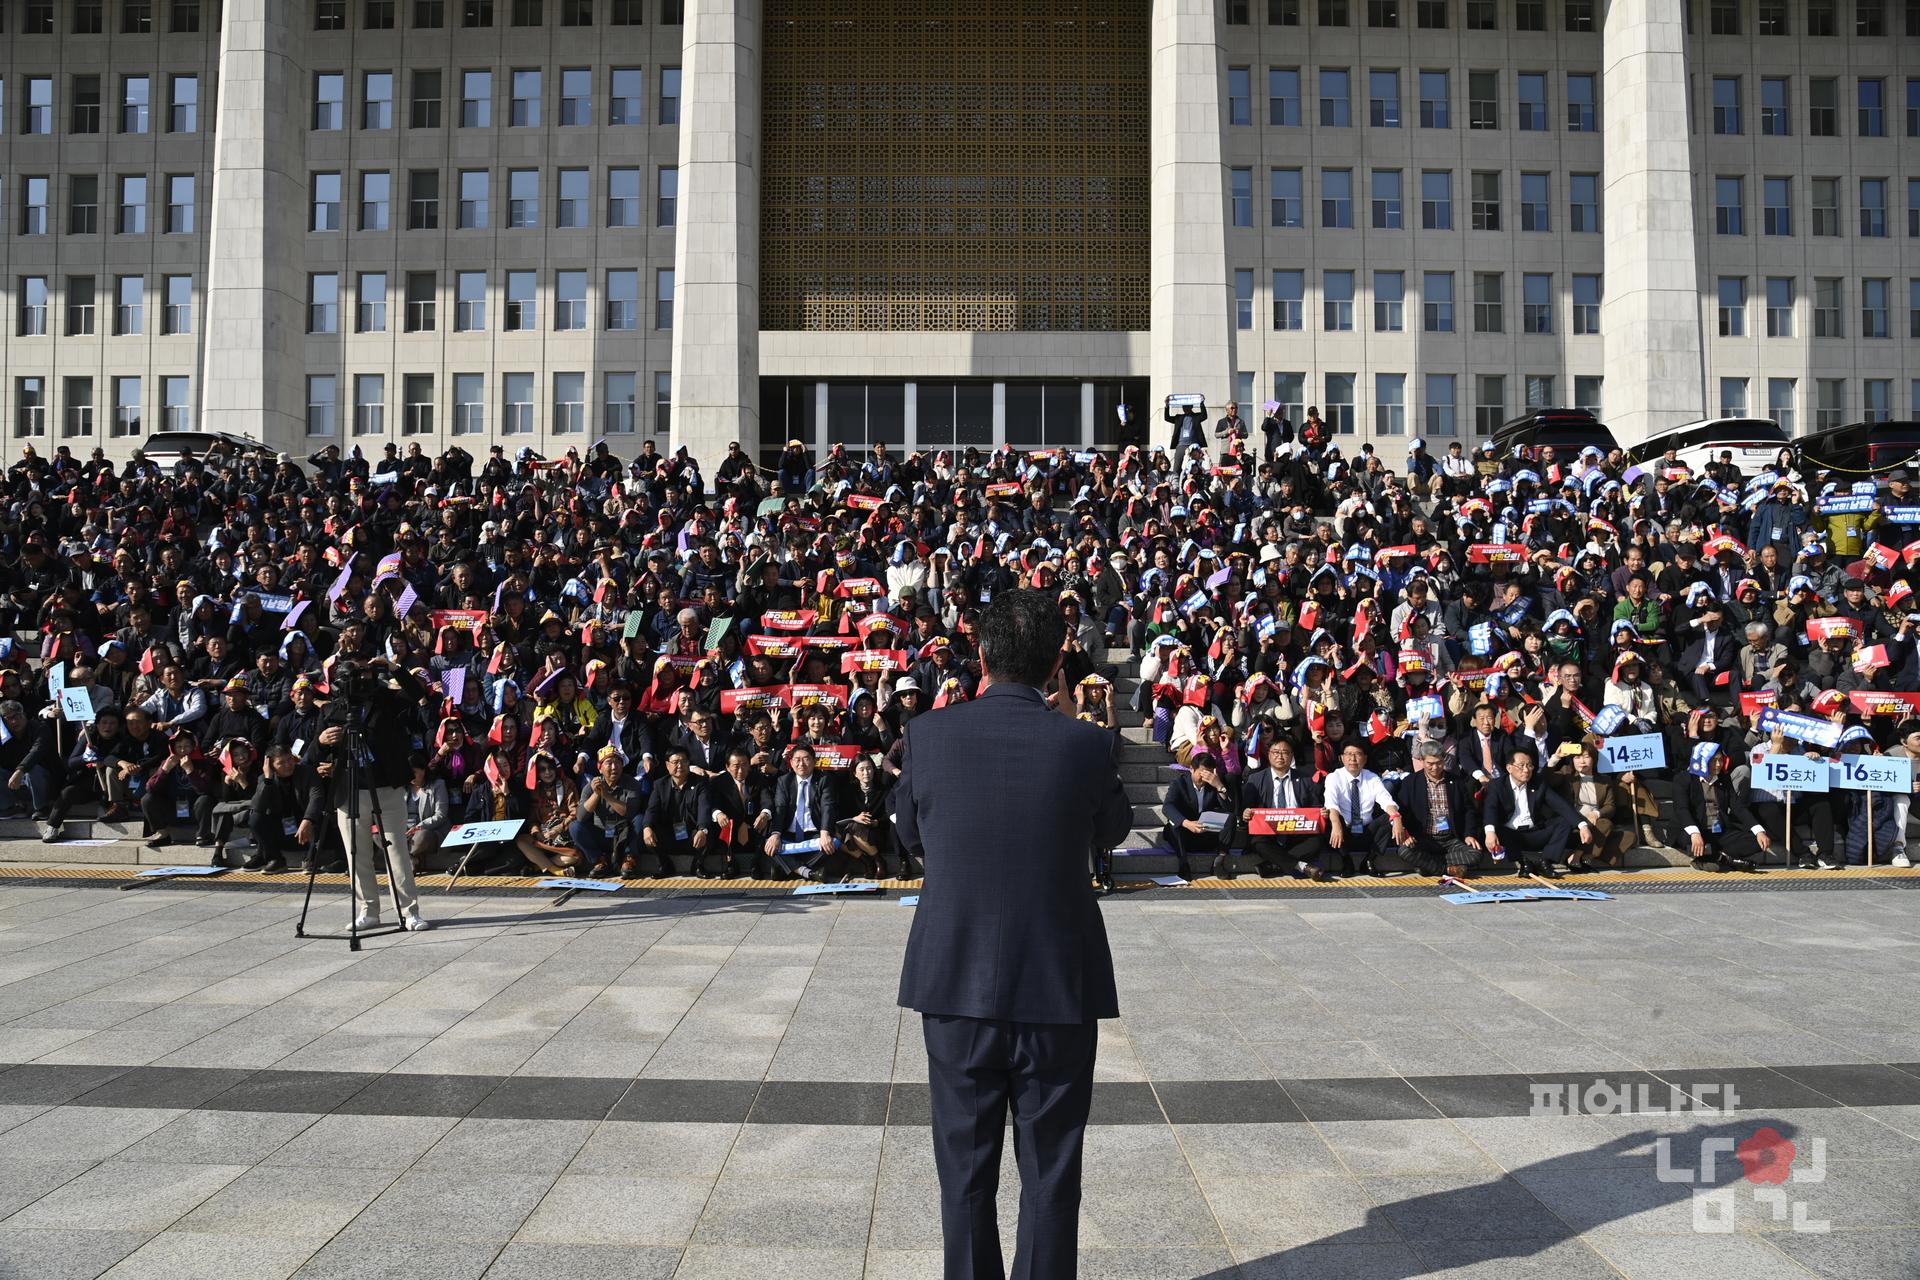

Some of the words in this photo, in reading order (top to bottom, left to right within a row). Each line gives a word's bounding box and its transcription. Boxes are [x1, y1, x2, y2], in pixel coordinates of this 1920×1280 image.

[1607, 745, 1654, 764] 14호차
[1765, 762, 1817, 783] 15호차
[1843, 762, 1898, 783] 16호차
[462, 827, 501, 840] 5호차
[1276, 820, 1318, 832] 남원으로!
